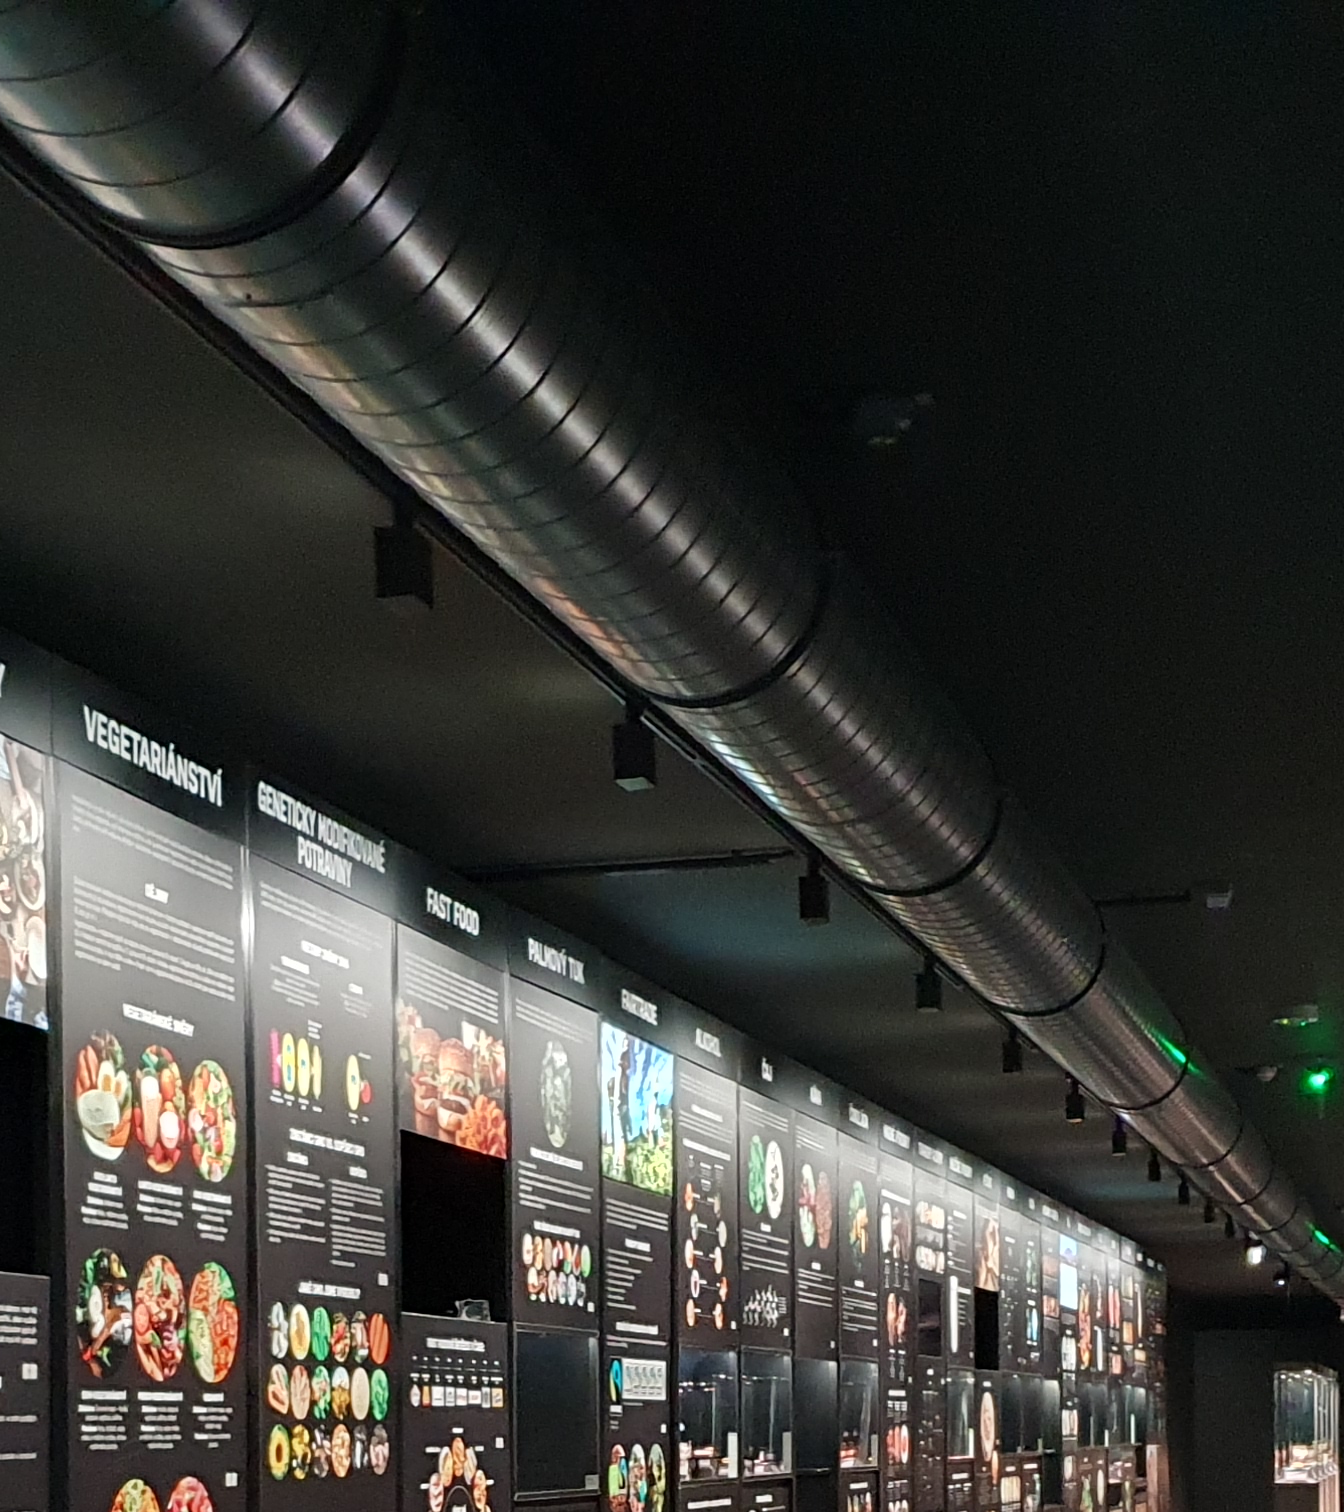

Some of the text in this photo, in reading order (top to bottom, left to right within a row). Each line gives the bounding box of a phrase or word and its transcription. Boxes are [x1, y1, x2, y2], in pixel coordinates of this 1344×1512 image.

[83, 704, 223, 807] VEGETARIÁNSTVÍ
[257, 780, 318, 837] GENETICKY
[297, 835, 353, 888] POTRAVINY
[427, 887, 480, 937] FAST FOOD
